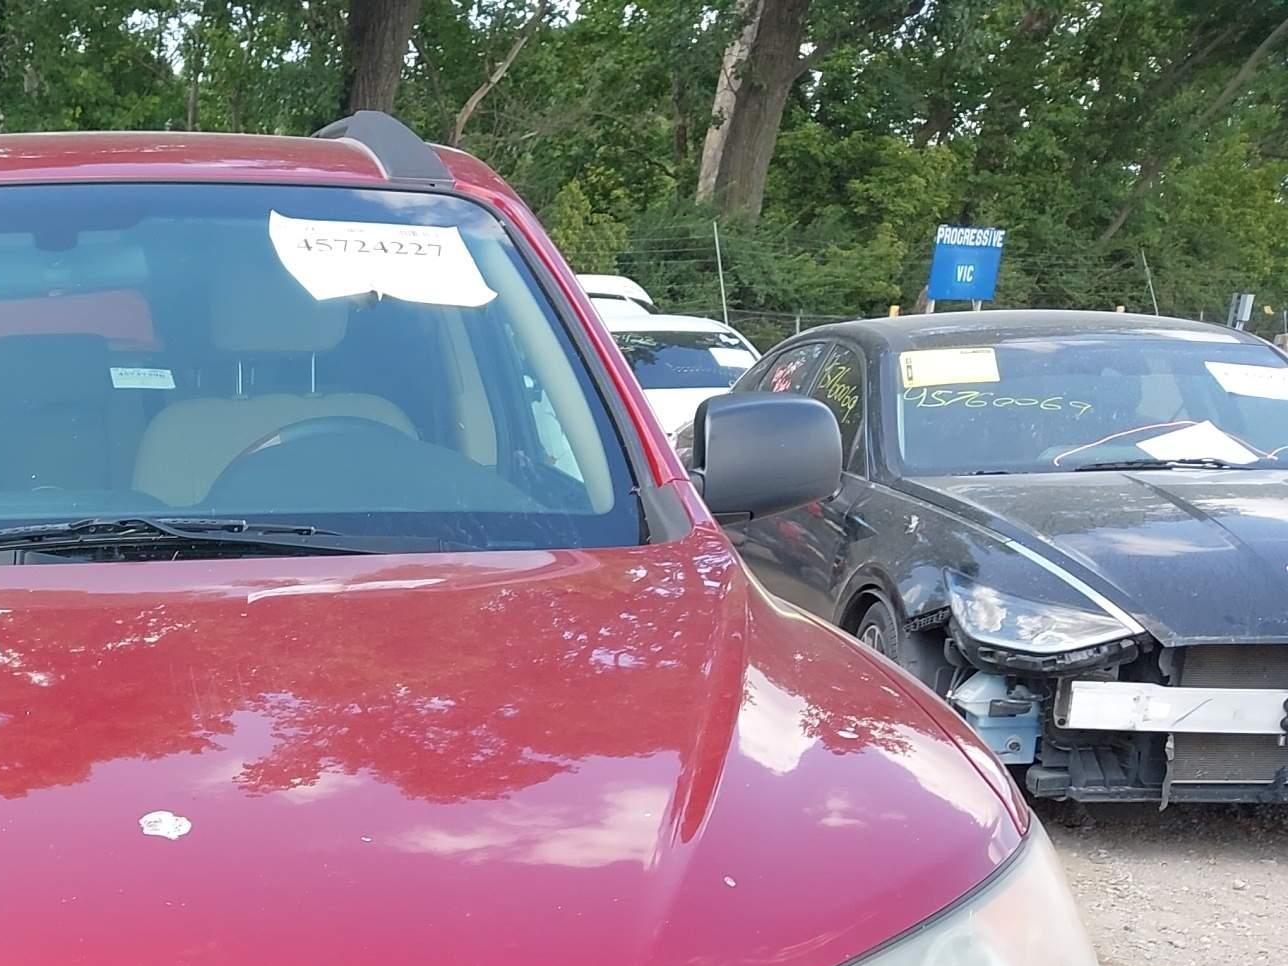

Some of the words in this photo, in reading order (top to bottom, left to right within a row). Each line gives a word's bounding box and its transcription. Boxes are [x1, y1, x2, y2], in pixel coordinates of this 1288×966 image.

[936, 227, 1005, 248] PROGRESSIVE
[297, 238, 442, 256] 45724227
[957, 265, 974, 282] VIC
